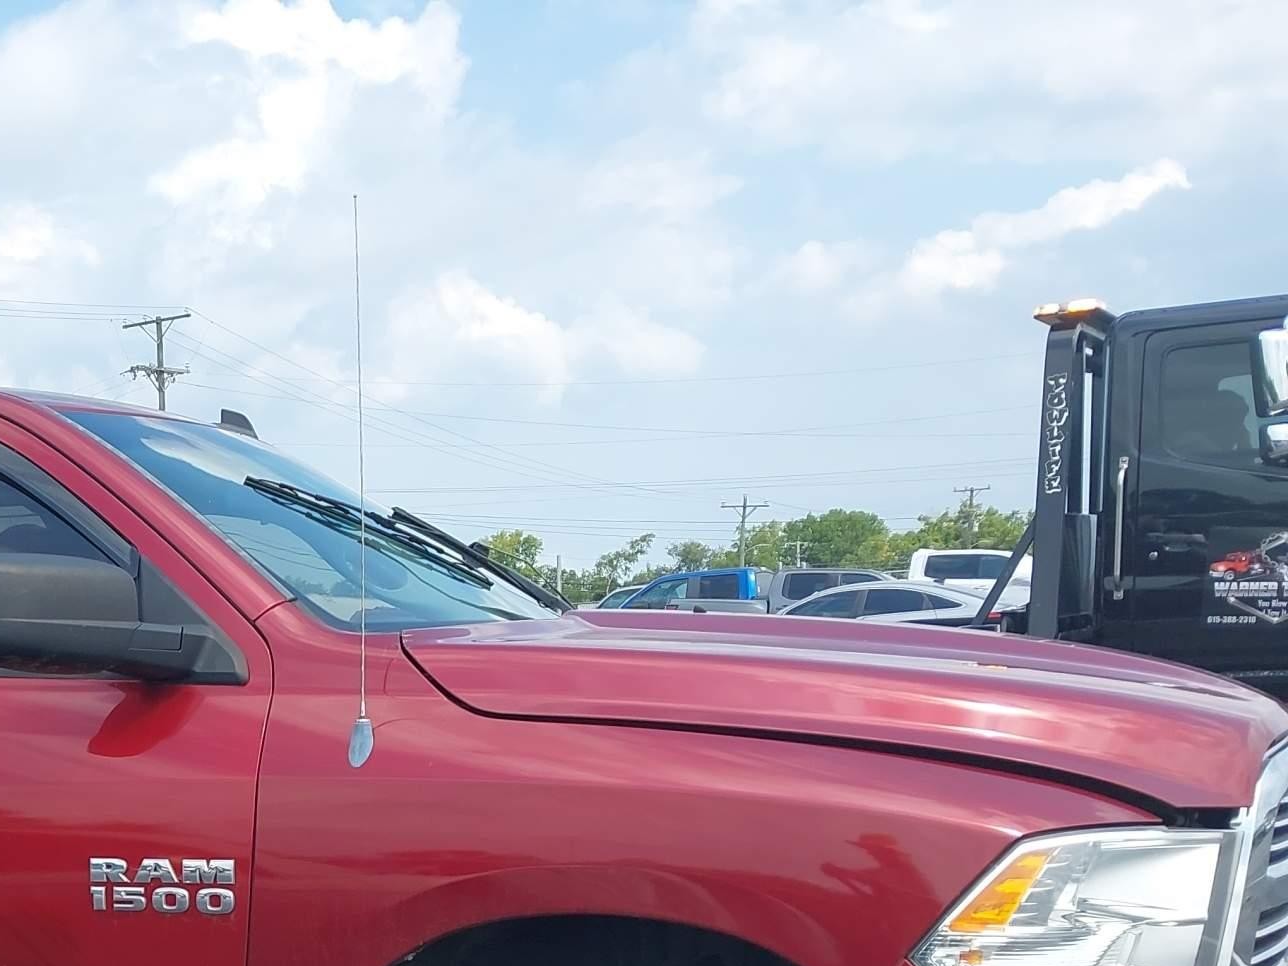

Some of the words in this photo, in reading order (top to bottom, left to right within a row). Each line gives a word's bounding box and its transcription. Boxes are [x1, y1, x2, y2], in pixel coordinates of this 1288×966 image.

[1214, 582, 1278, 597] WARNER
[89, 857, 235, 885] RAM
[90, 886, 235, 914] 1500
